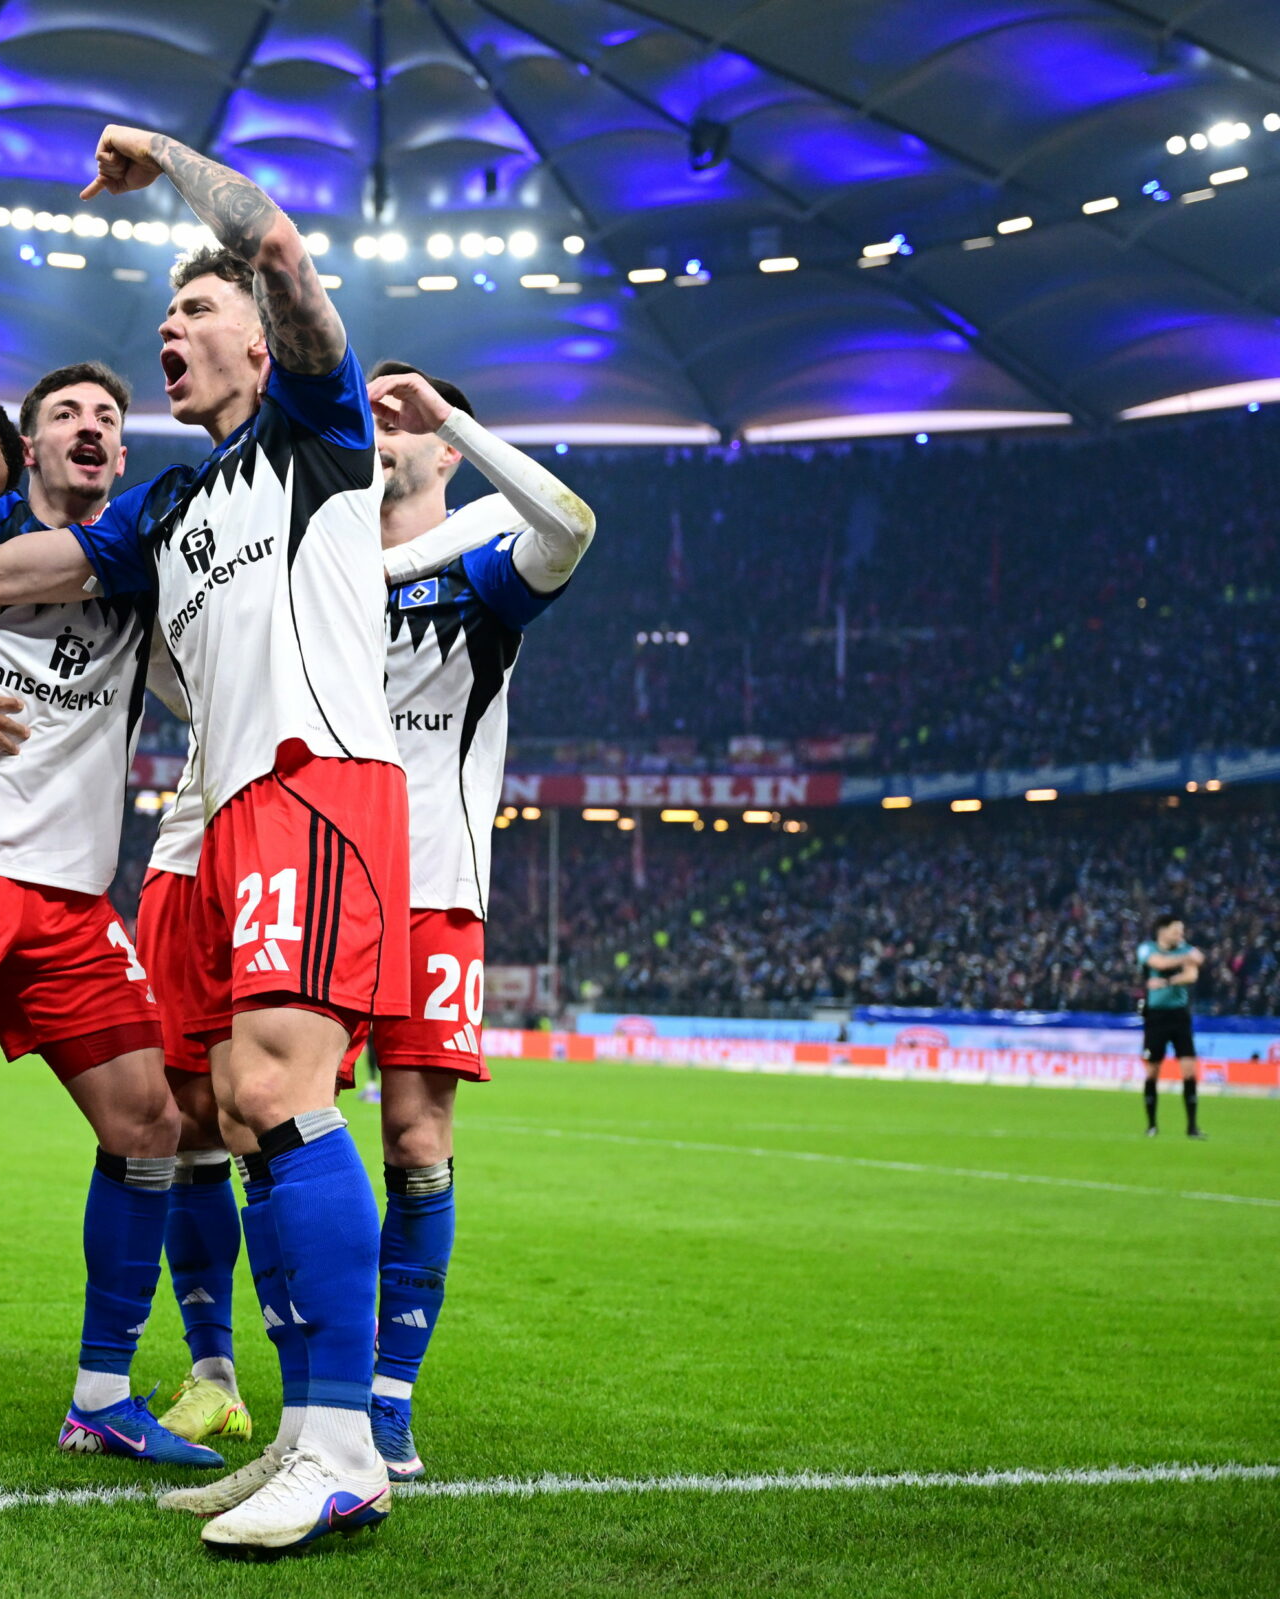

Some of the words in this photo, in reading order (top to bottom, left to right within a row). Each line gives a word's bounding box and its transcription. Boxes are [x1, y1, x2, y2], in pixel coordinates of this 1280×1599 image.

[390, 710, 453, 731] rkur
[583, 775, 808, 805] BERLIN
[233, 868, 302, 949] 21
[424, 954, 484, 1026] 20
